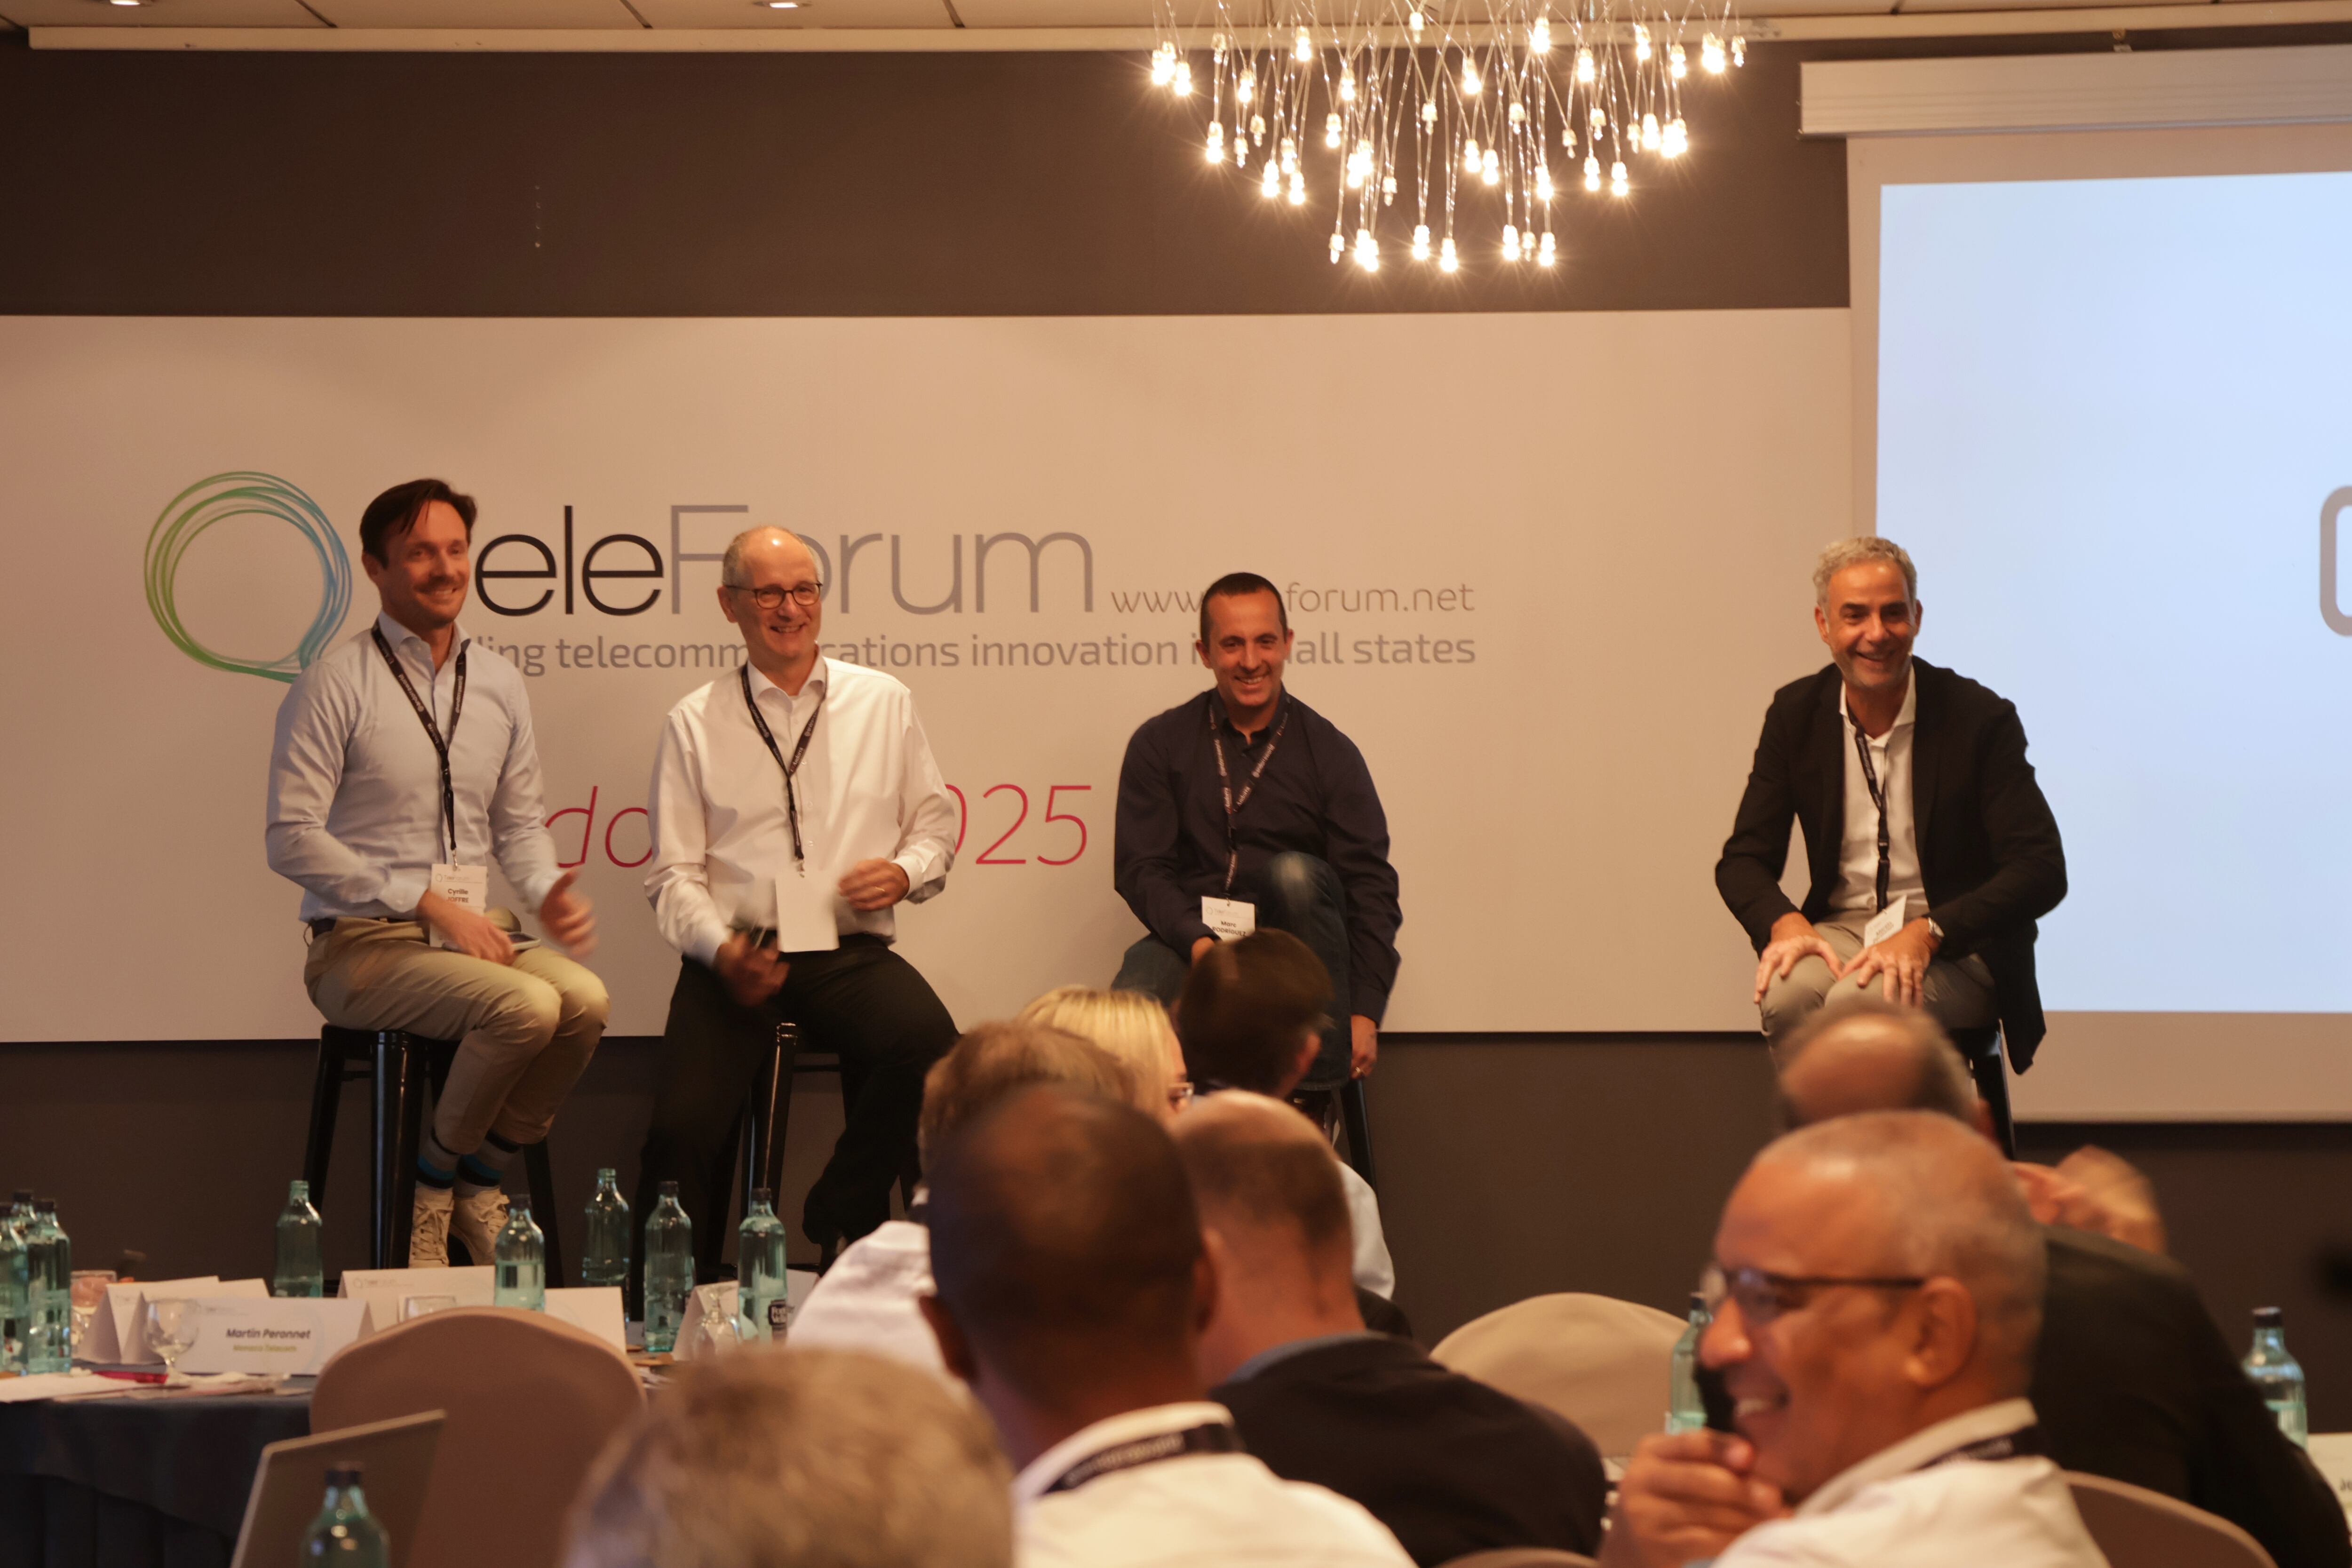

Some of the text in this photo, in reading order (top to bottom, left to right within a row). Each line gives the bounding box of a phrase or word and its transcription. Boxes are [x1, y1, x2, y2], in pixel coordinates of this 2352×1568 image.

[972, 633, 1177, 666] innovation
[1353, 633, 1476, 664] states
[793, 747, 803, 766] Andorra
[226, 1328, 261, 1338] Martin
